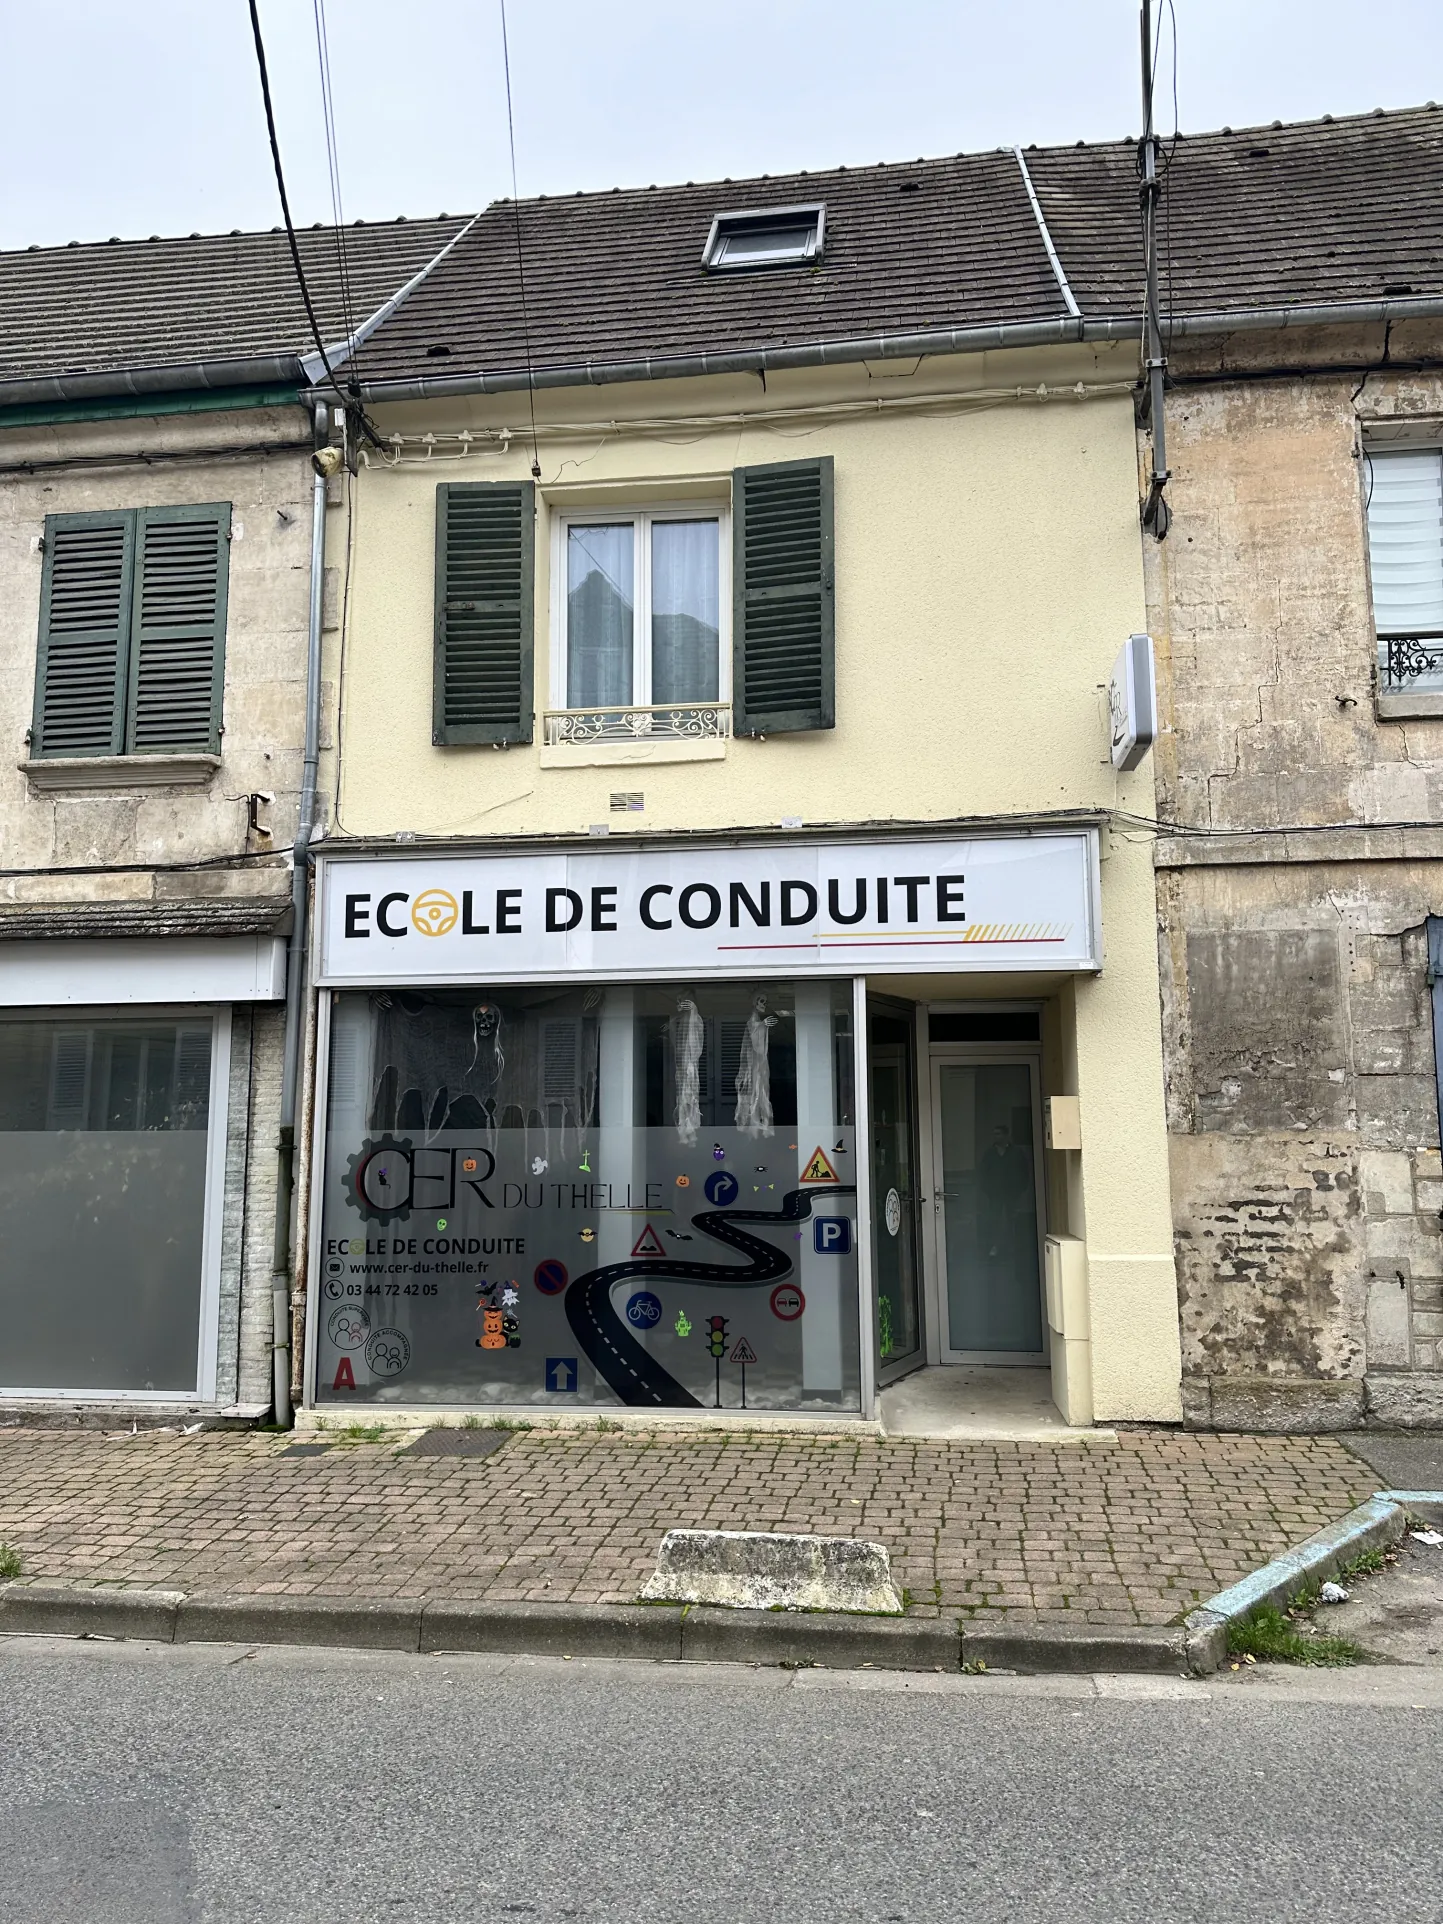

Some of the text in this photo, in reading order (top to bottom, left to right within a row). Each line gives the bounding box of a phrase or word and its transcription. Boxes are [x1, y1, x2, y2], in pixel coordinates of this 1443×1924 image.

[345, 875, 965, 938] ECOLE DE CONDUITE
[357, 1147, 663, 1210] CER DU THELLE
[327, 1238, 525, 1255] ECOLE DE CONDUITE
[822, 1222, 841, 1248] P
[349, 1261, 489, 1274] www.cer-du-thelle.fr
[347, 1284, 438, 1296] 03 44 72 42 05
[366, 1332, 381, 1361] CONDUITE
[332, 1356, 356, 1390] A
